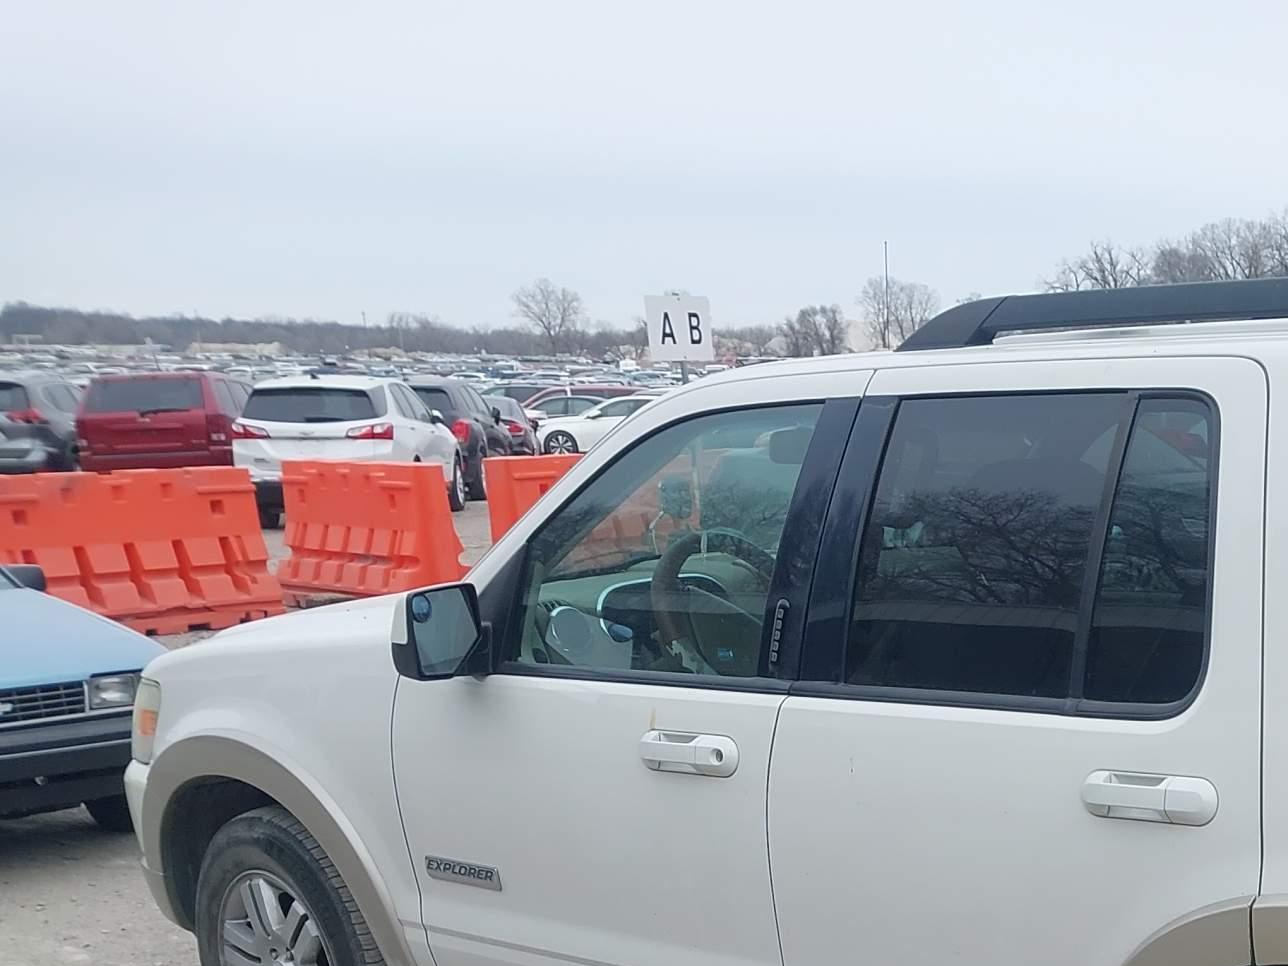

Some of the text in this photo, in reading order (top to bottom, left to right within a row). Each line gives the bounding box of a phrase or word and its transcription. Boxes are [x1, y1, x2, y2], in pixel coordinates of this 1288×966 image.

[661, 311, 703, 345] A B
[426, 859, 494, 881] EXPLORER
